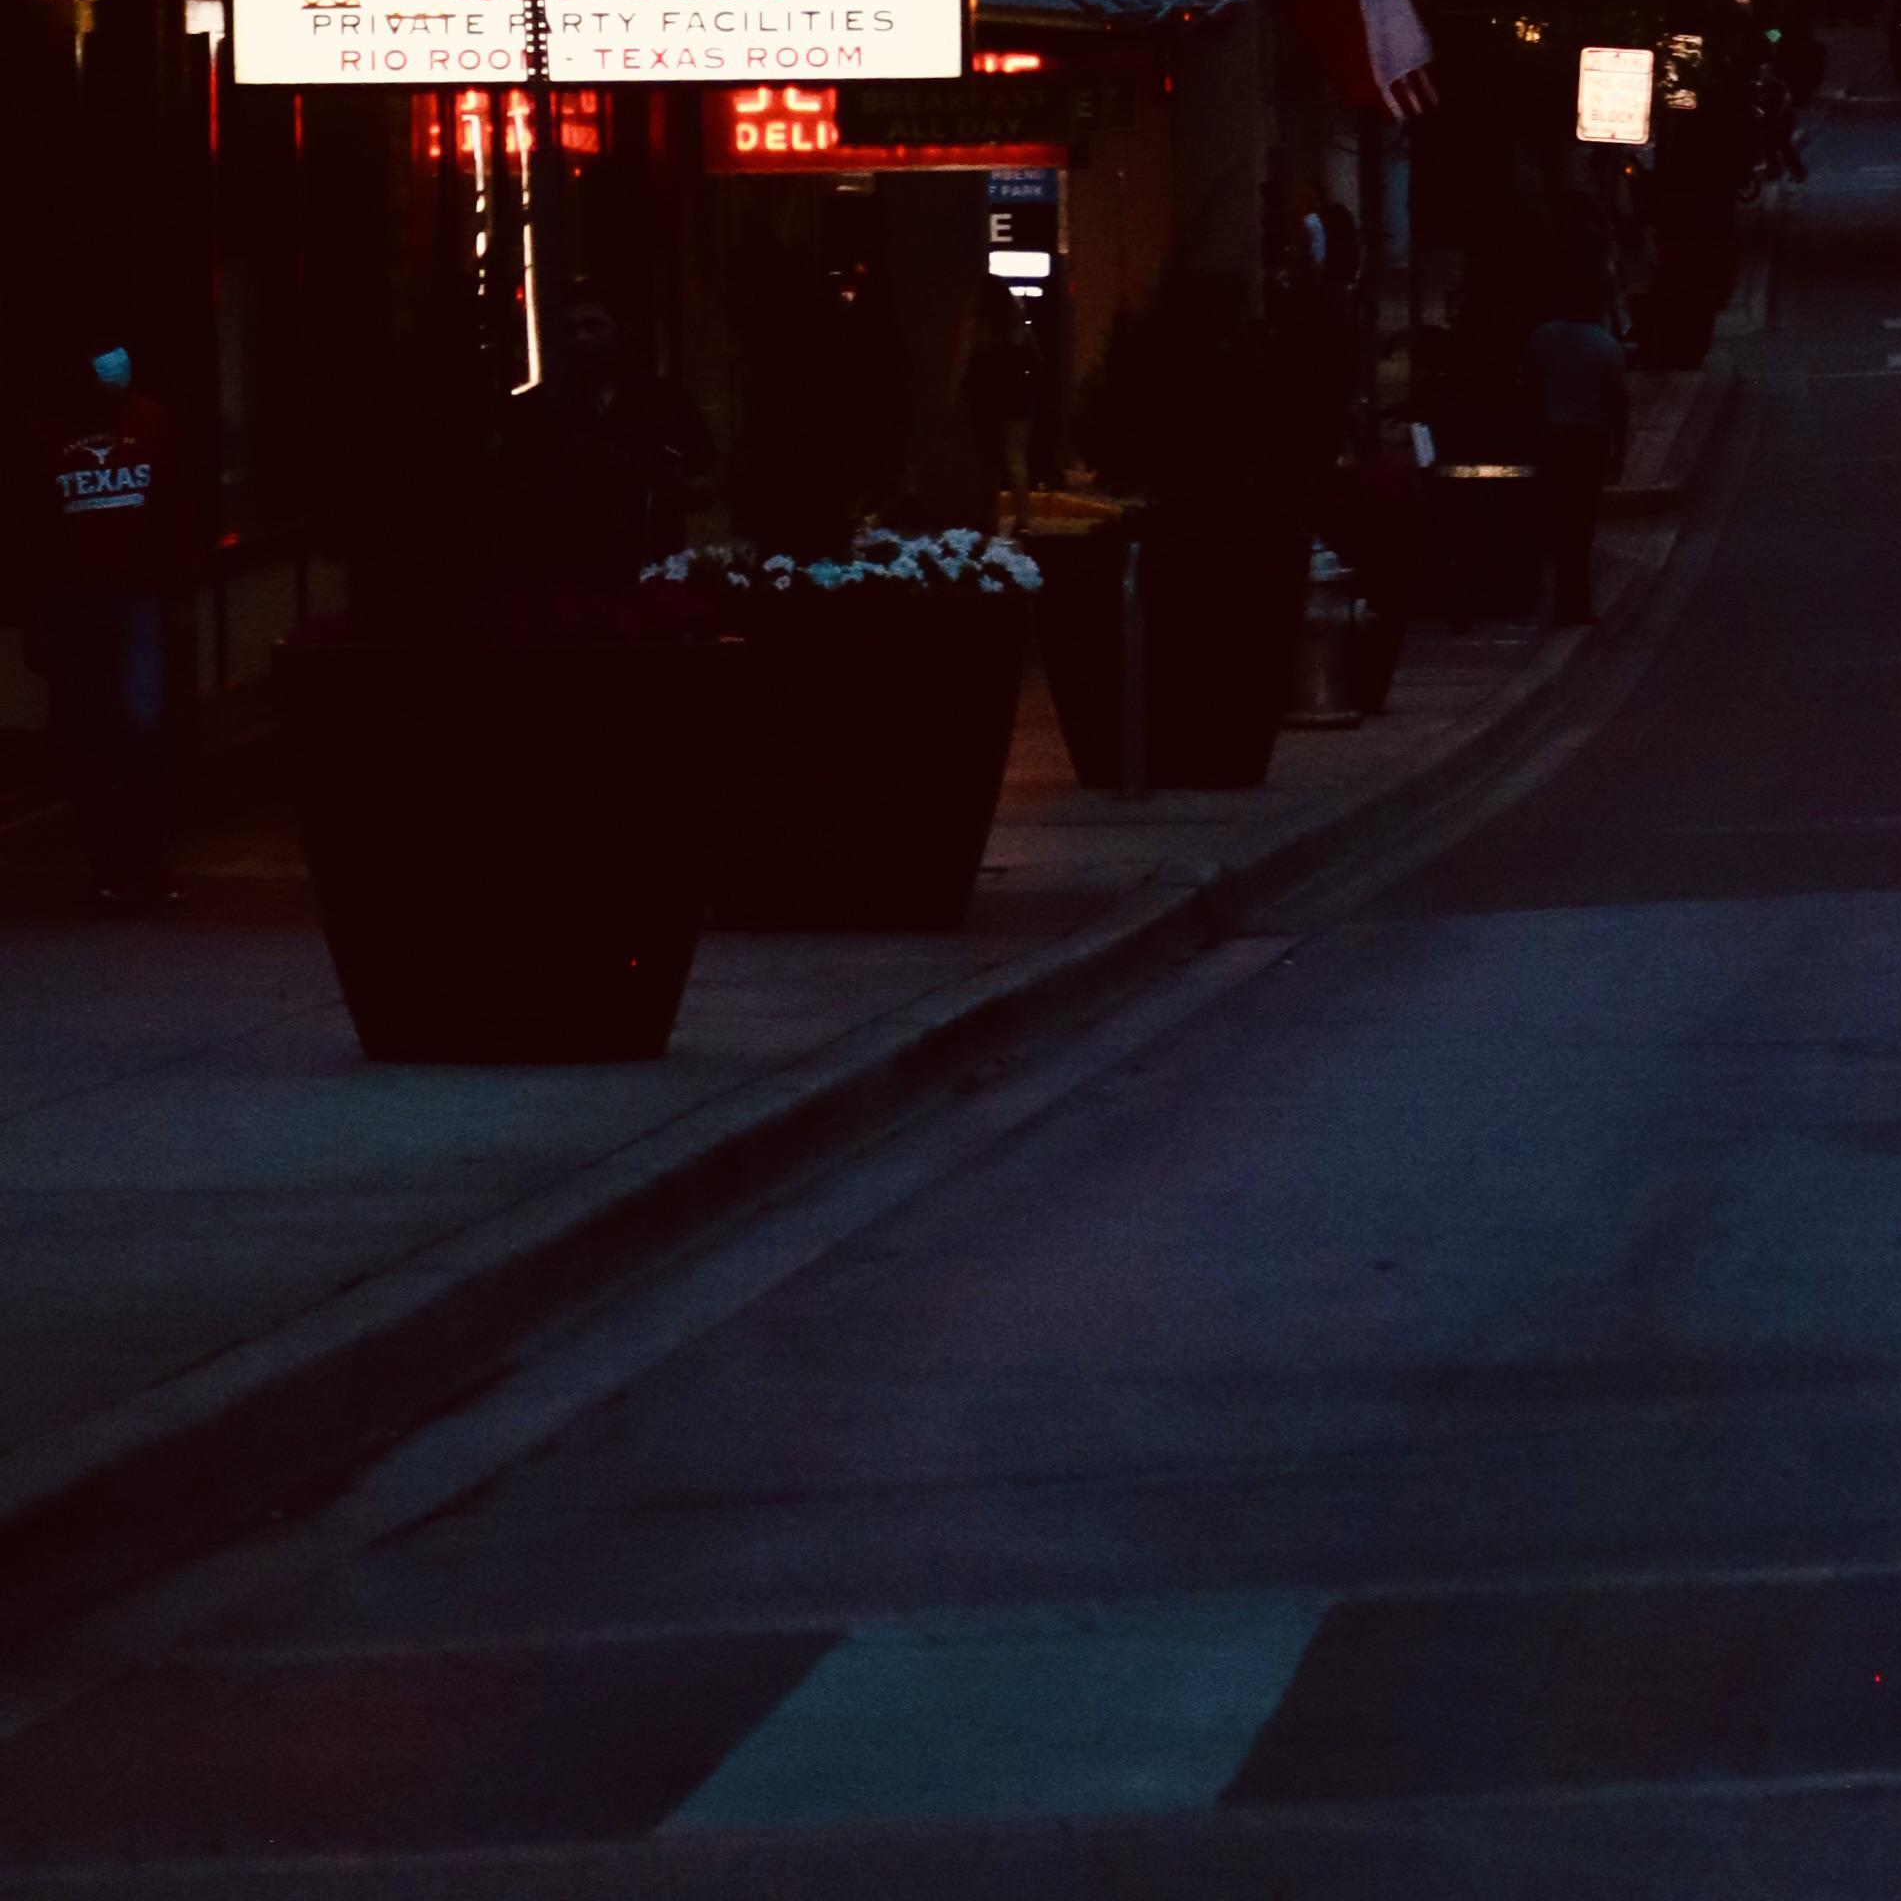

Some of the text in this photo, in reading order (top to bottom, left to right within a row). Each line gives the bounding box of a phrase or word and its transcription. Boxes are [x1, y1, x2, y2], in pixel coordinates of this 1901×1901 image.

[312, 9, 894, 35] PRIVATE PRTY FACILITIES
[340, 49, 407, 72] RIO
[594, 47, 725, 70] TEXAS
[747, 45, 864, 68] ROOM
[56, 463, 151, 497] TEXAS
